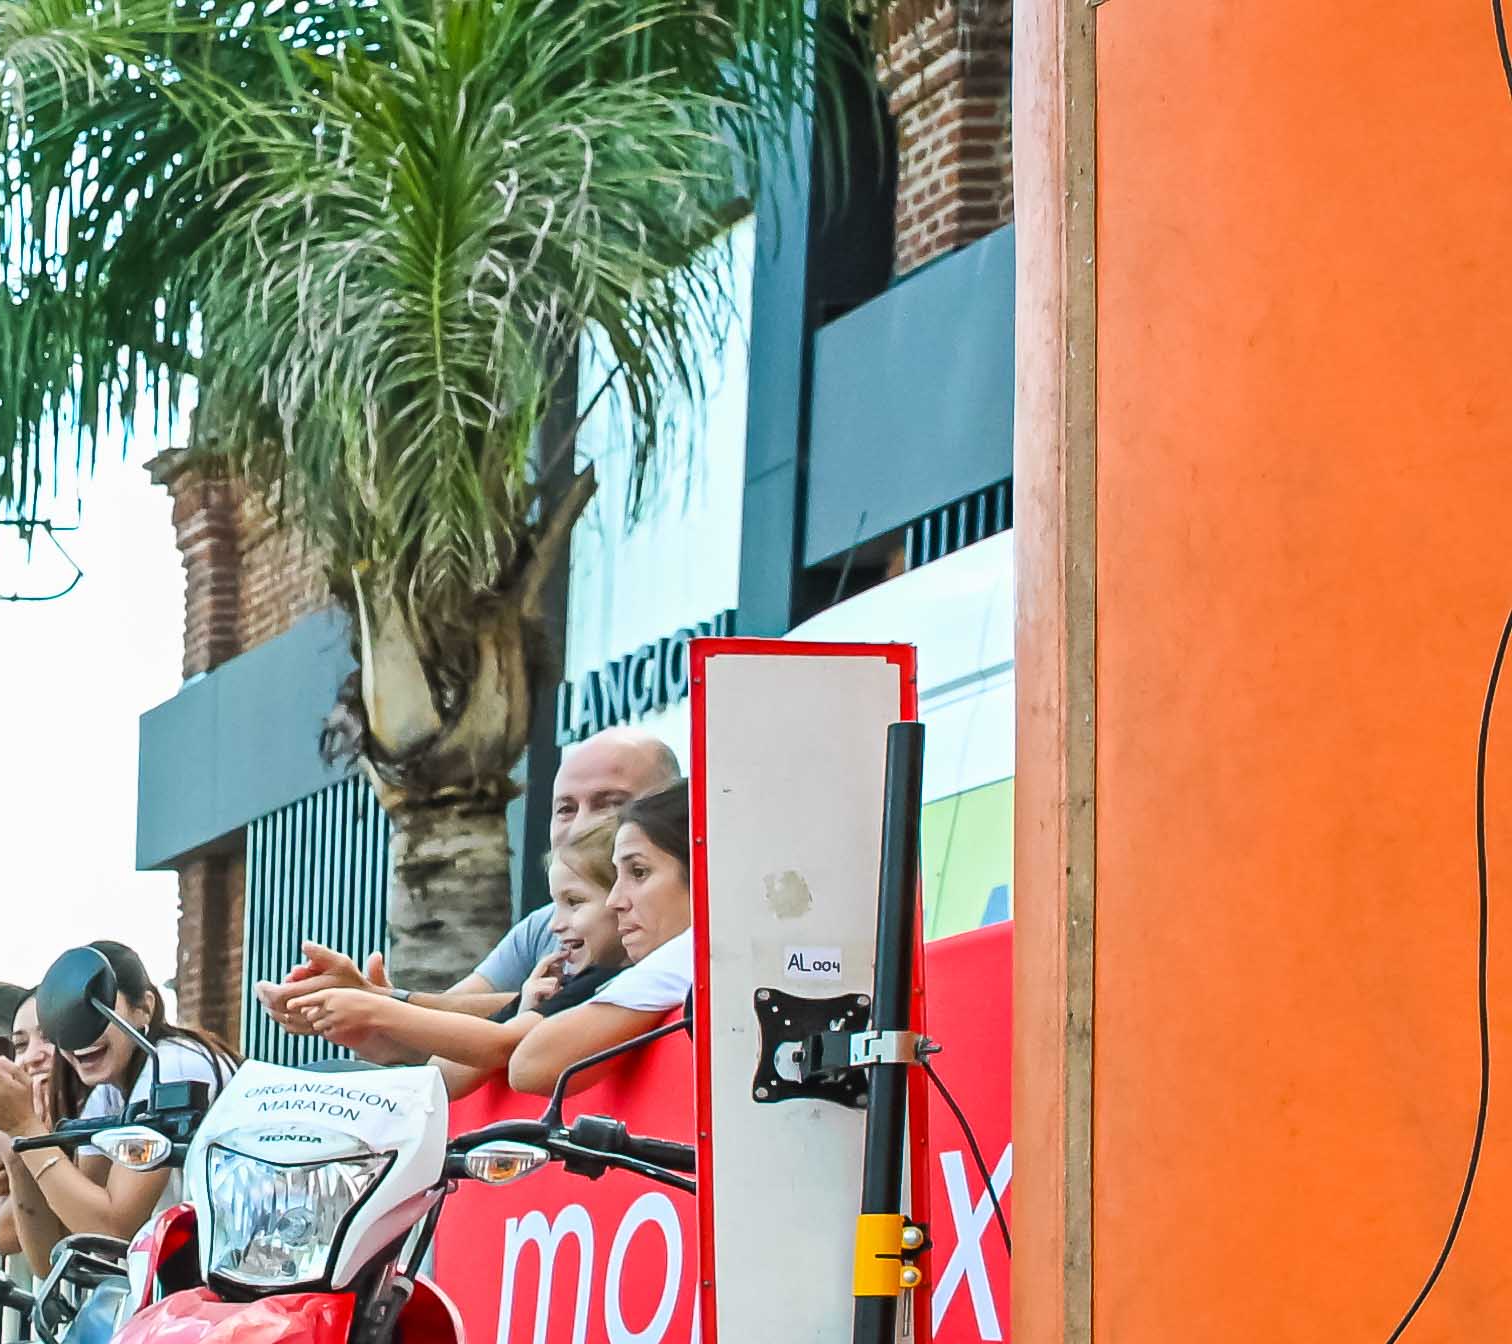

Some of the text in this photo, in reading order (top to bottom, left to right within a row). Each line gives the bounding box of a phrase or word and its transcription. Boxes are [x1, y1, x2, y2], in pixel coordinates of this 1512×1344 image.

[554, 609, 738, 748] LANCIO
[244, 1083, 398, 1113] ORGANIZACION
[257, 1099, 361, 1121] MARATON
[258, 1133, 323, 1144] HONDA
